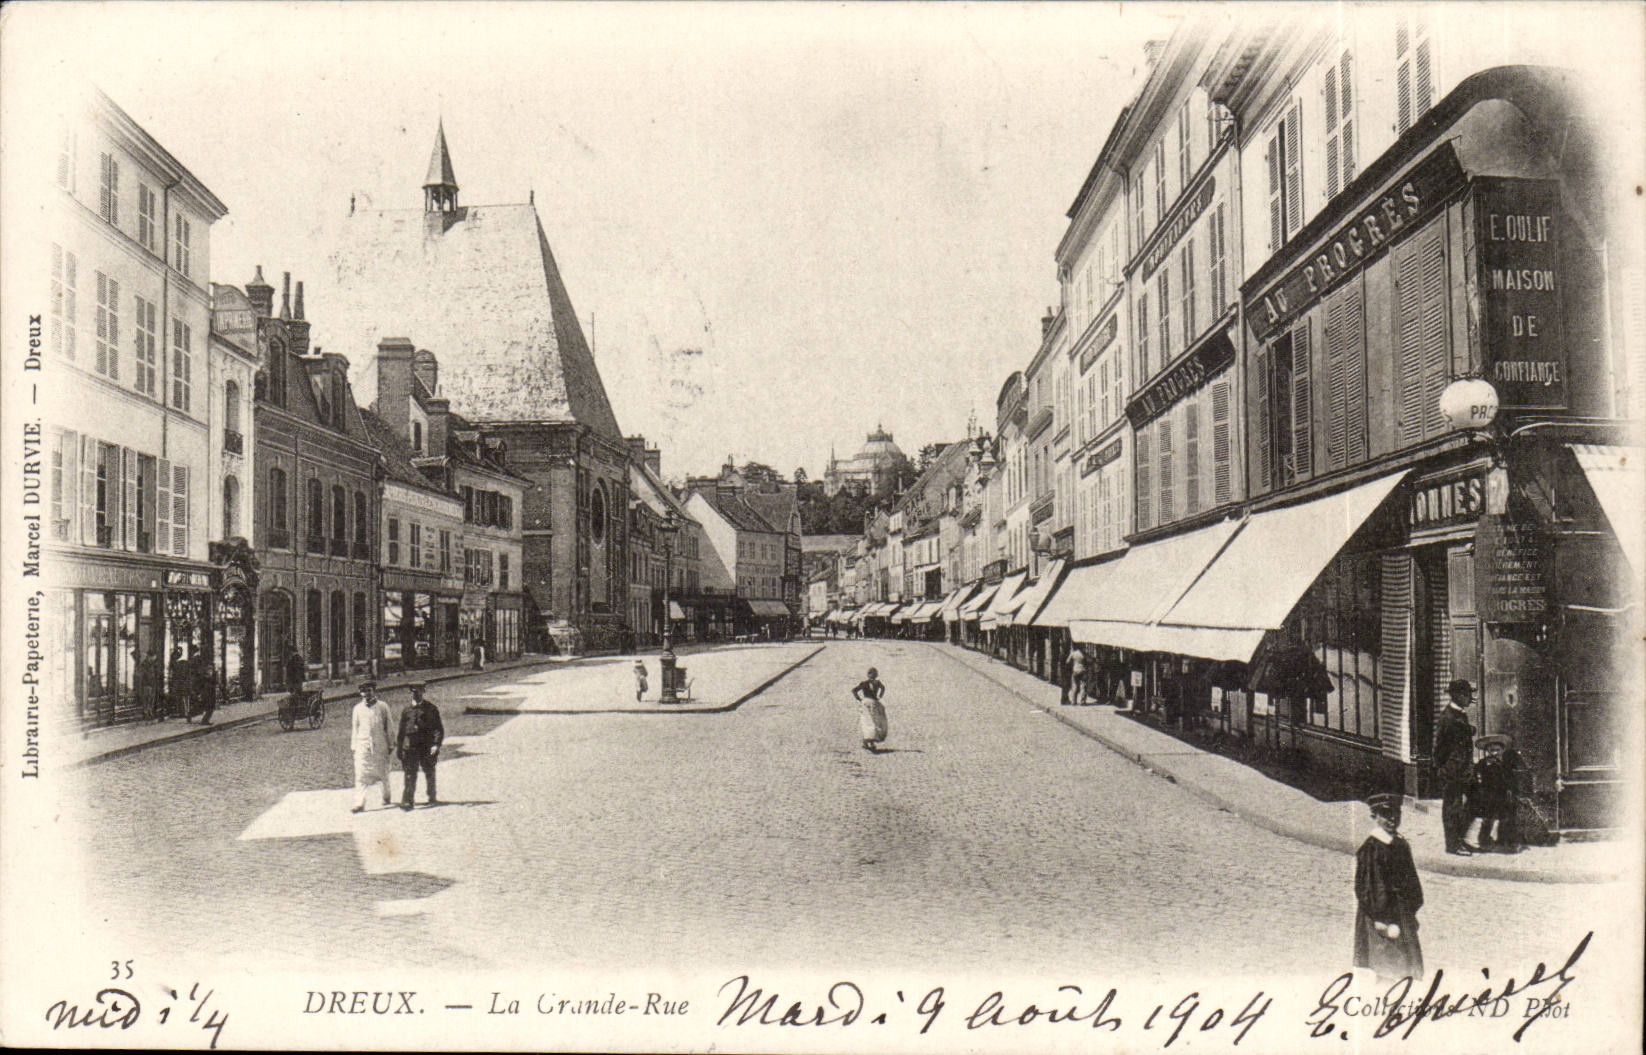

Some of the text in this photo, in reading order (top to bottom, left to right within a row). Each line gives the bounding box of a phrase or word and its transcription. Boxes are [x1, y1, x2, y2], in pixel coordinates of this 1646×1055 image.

[1492, 269, 1555, 291] MAISON
[1264, 286, 1288, 325] AU
[1512, 315, 1539, 337] DE
[916, 986, 946, 1035] 9
[1142, 990, 1275, 1048] 1904
